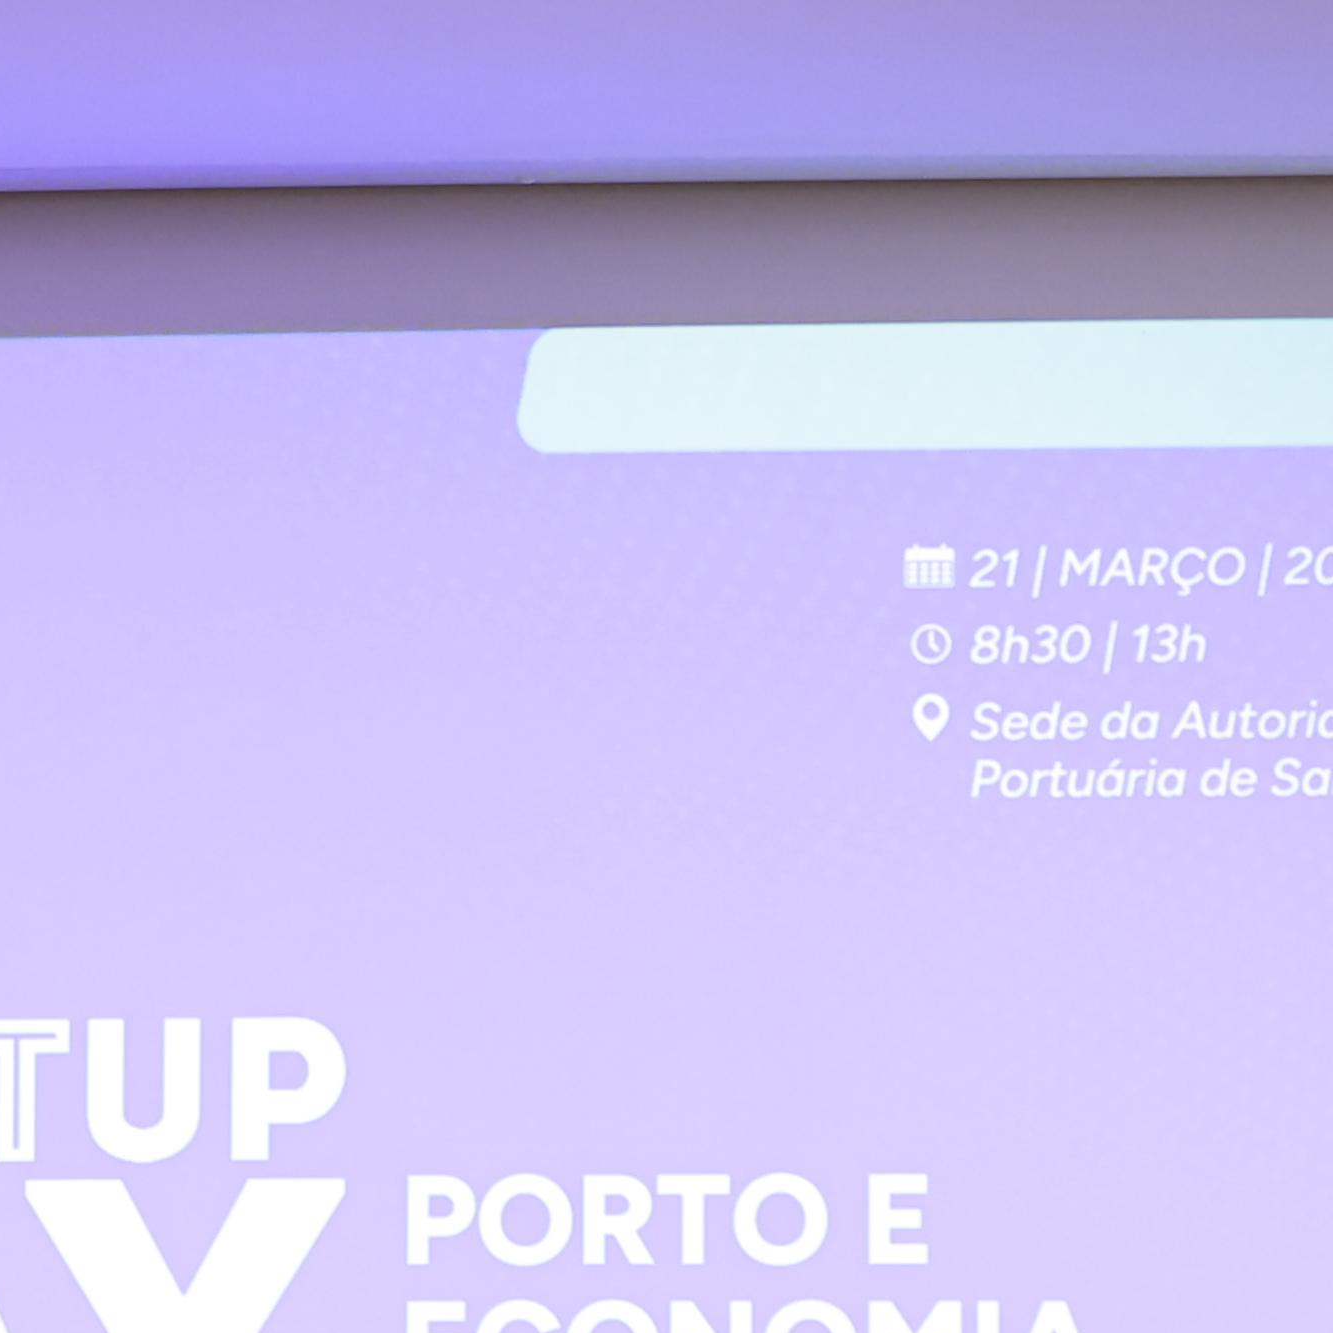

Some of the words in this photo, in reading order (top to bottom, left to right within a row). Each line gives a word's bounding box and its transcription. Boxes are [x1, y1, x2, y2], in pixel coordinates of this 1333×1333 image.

[969, 548, 1019, 588] 21
[1060, 546, 1245, 596] MARÇO
[970, 623, 1092, 664] 8h30
[1133, 623, 1207, 662] 13h
[970, 701, 1089, 741] Sede
[1101, 701, 1160, 740] da
[971, 756, 1188, 798] Portuária
[1200, 759, 1258, 797] de
[1271, 756, 1333, 797] Sa
[405, 1171, 829, 1268] PORTO
[867, 1172, 929, 1266] E
